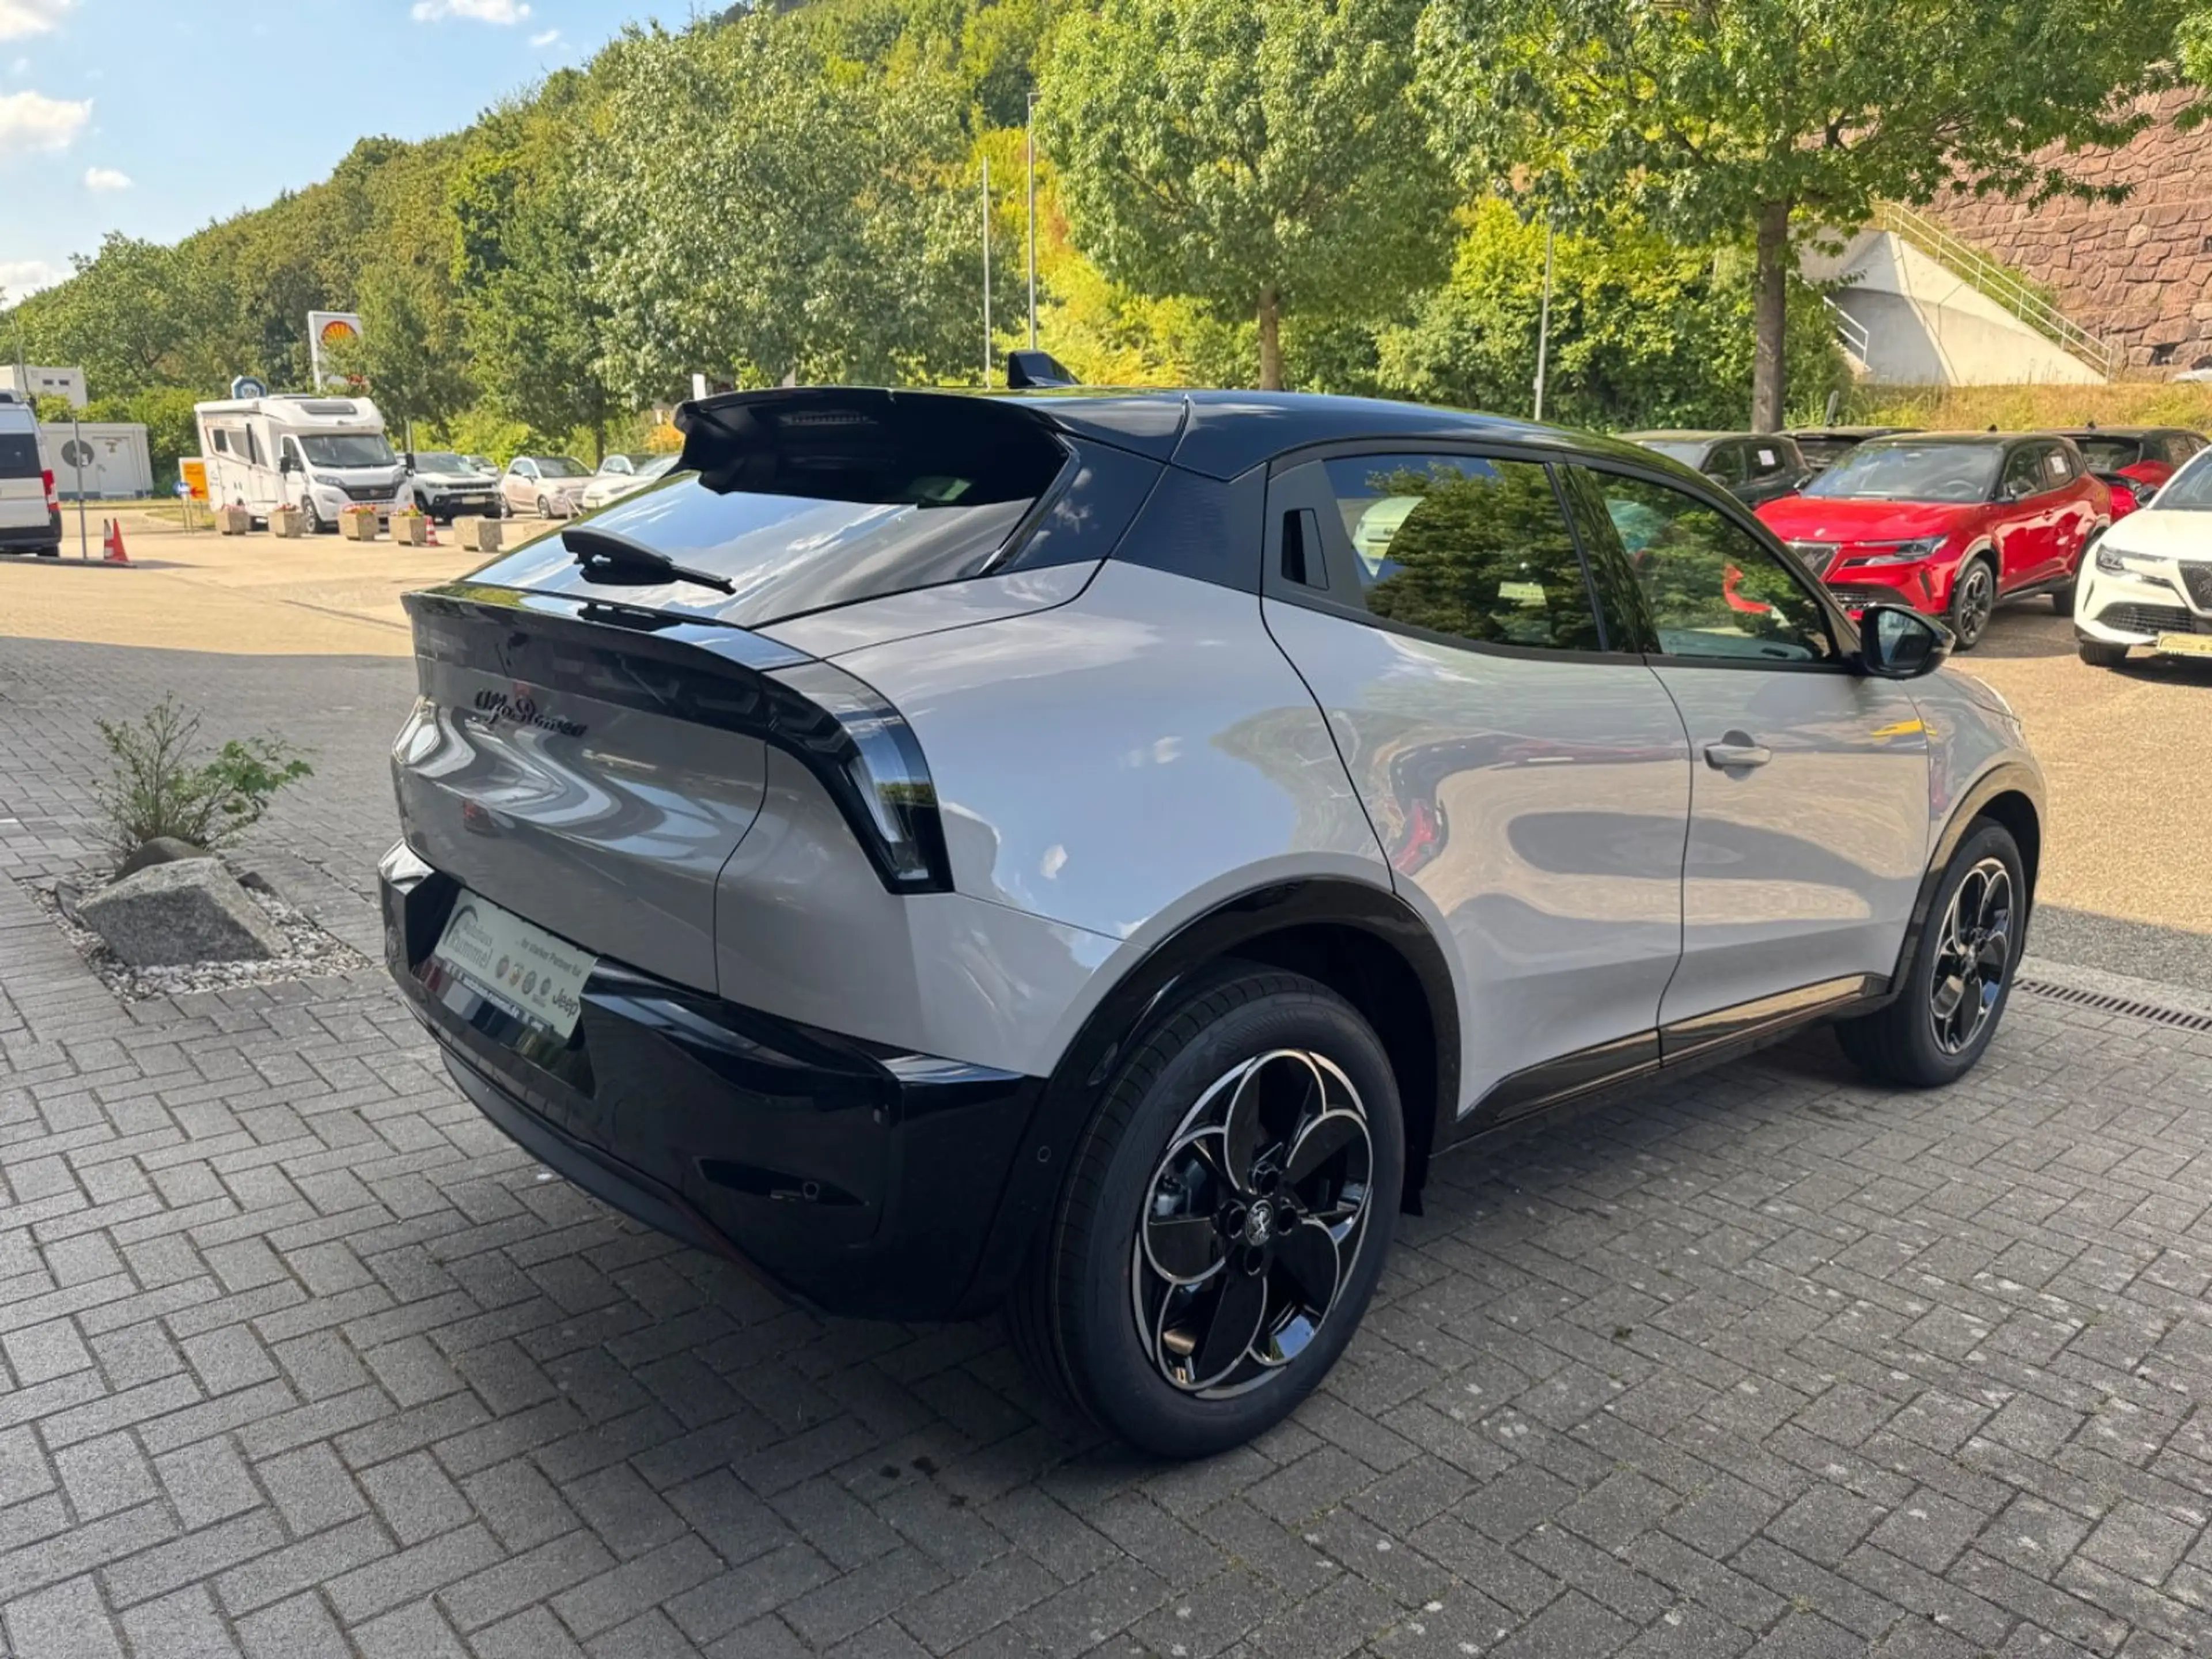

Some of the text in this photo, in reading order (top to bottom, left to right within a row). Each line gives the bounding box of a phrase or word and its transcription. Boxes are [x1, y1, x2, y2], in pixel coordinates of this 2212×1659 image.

[475, 690, 588, 736] Alfa Romeo
[552, 988, 579, 1018] Jeep
